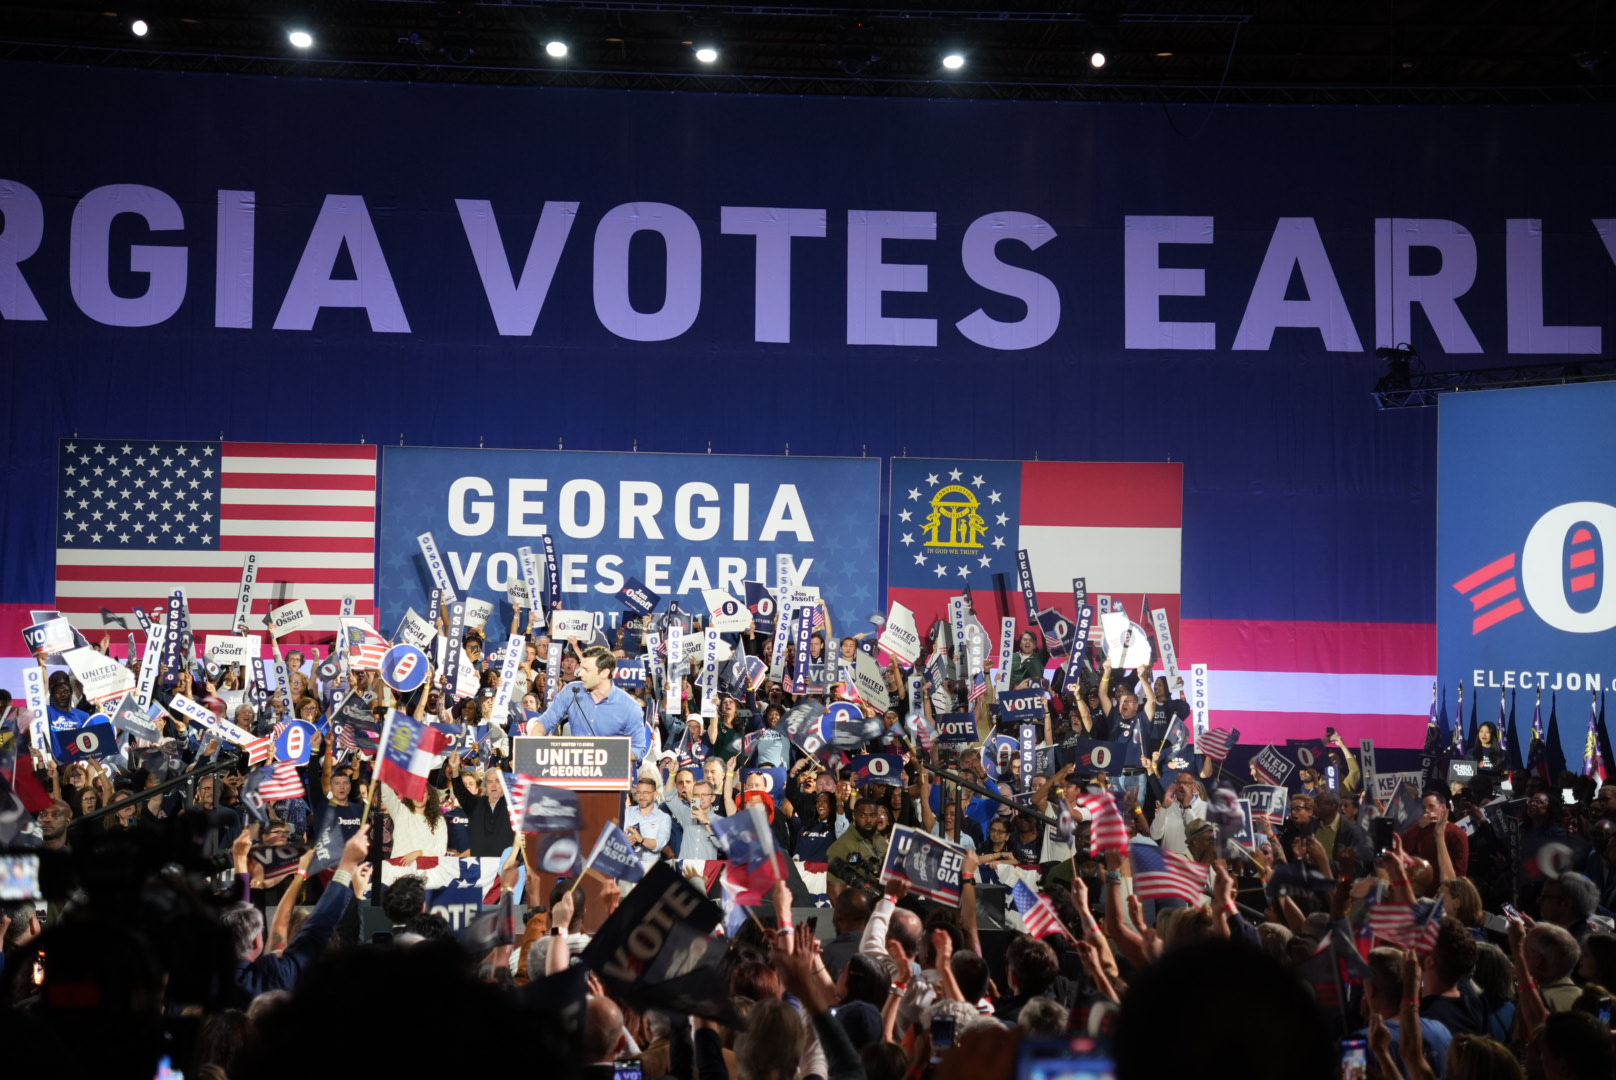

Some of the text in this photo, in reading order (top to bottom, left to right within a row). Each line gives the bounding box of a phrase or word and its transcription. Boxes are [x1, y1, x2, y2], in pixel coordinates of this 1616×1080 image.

[454, 198, 1061, 350] VOTES
[1124, 215, 1616, 354] EARL
[448, 476, 815, 542] GEORGIA
[238, 555, 256, 623] GEORGIA
[1018, 551, 1036, 617] GEORGIA
[276, 610, 304, 627] Ossoff
[280, 609, 294, 619] Jon
[889, 623, 917, 643] UNITED
[212, 647, 243, 655] Ossoff
[220, 641, 234, 649] Jon
[796, 607, 811, 684] GEORGIA
[81, 664, 117, 680] UNITED
[138, 626, 163, 706] UNITED
[858, 672, 884, 692] UNITED
[1003, 696, 1043, 712] VOTE
[936, 721, 974, 735] VOTE
[535, 748, 608, 766] UNITED
[550, 765, 603, 777] GEORGIA
[607, 836, 628, 854] Jon
[602, 880, 700, 982] VOTE
